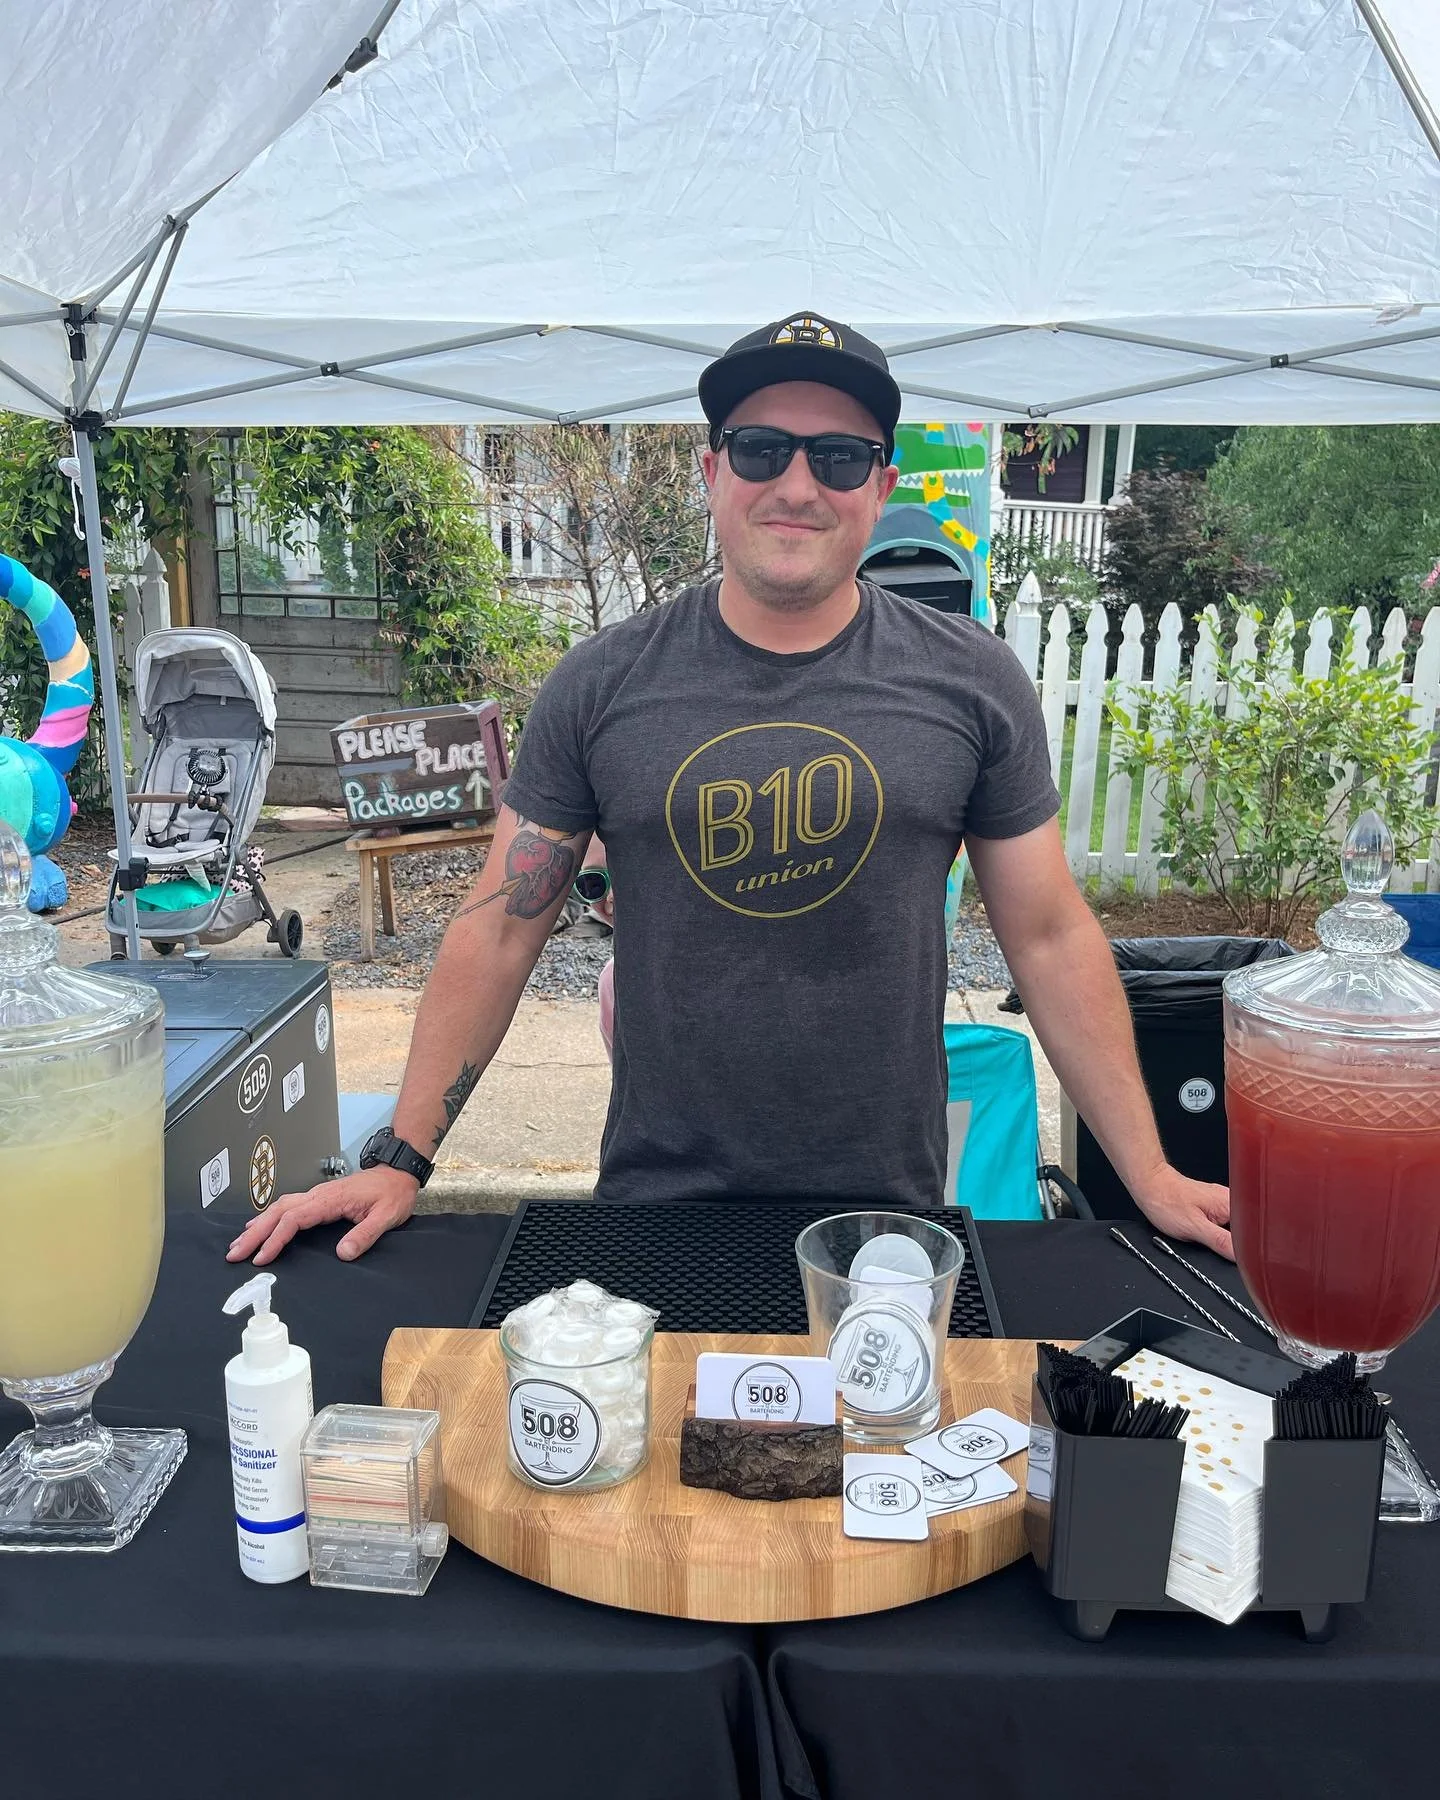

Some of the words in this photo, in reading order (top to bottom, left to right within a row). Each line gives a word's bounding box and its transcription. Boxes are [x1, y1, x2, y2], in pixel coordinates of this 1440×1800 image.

[338, 720, 427, 762] PLEASE
[415, 741, 487, 776] PLACE
[344, 780, 463, 820] Packages
[698, 753, 852, 871] B10
[735, 856, 834, 893] union
[243, 1062, 267, 1105] 508
[1187, 1088, 1207, 1098] 508
[851, 1328, 890, 1390] 508
[879, 1343, 901, 1392] BARTENDING
[747, 1384, 788, 1405] 508
[521, 1404, 579, 1441] 508
[231, 1443, 279, 1459] FESSIONAL
[524, 1438, 573, 1454] BARTENDING
[960, 1435, 994, 1453] 508
[879, 1482, 900, 1506] 508
